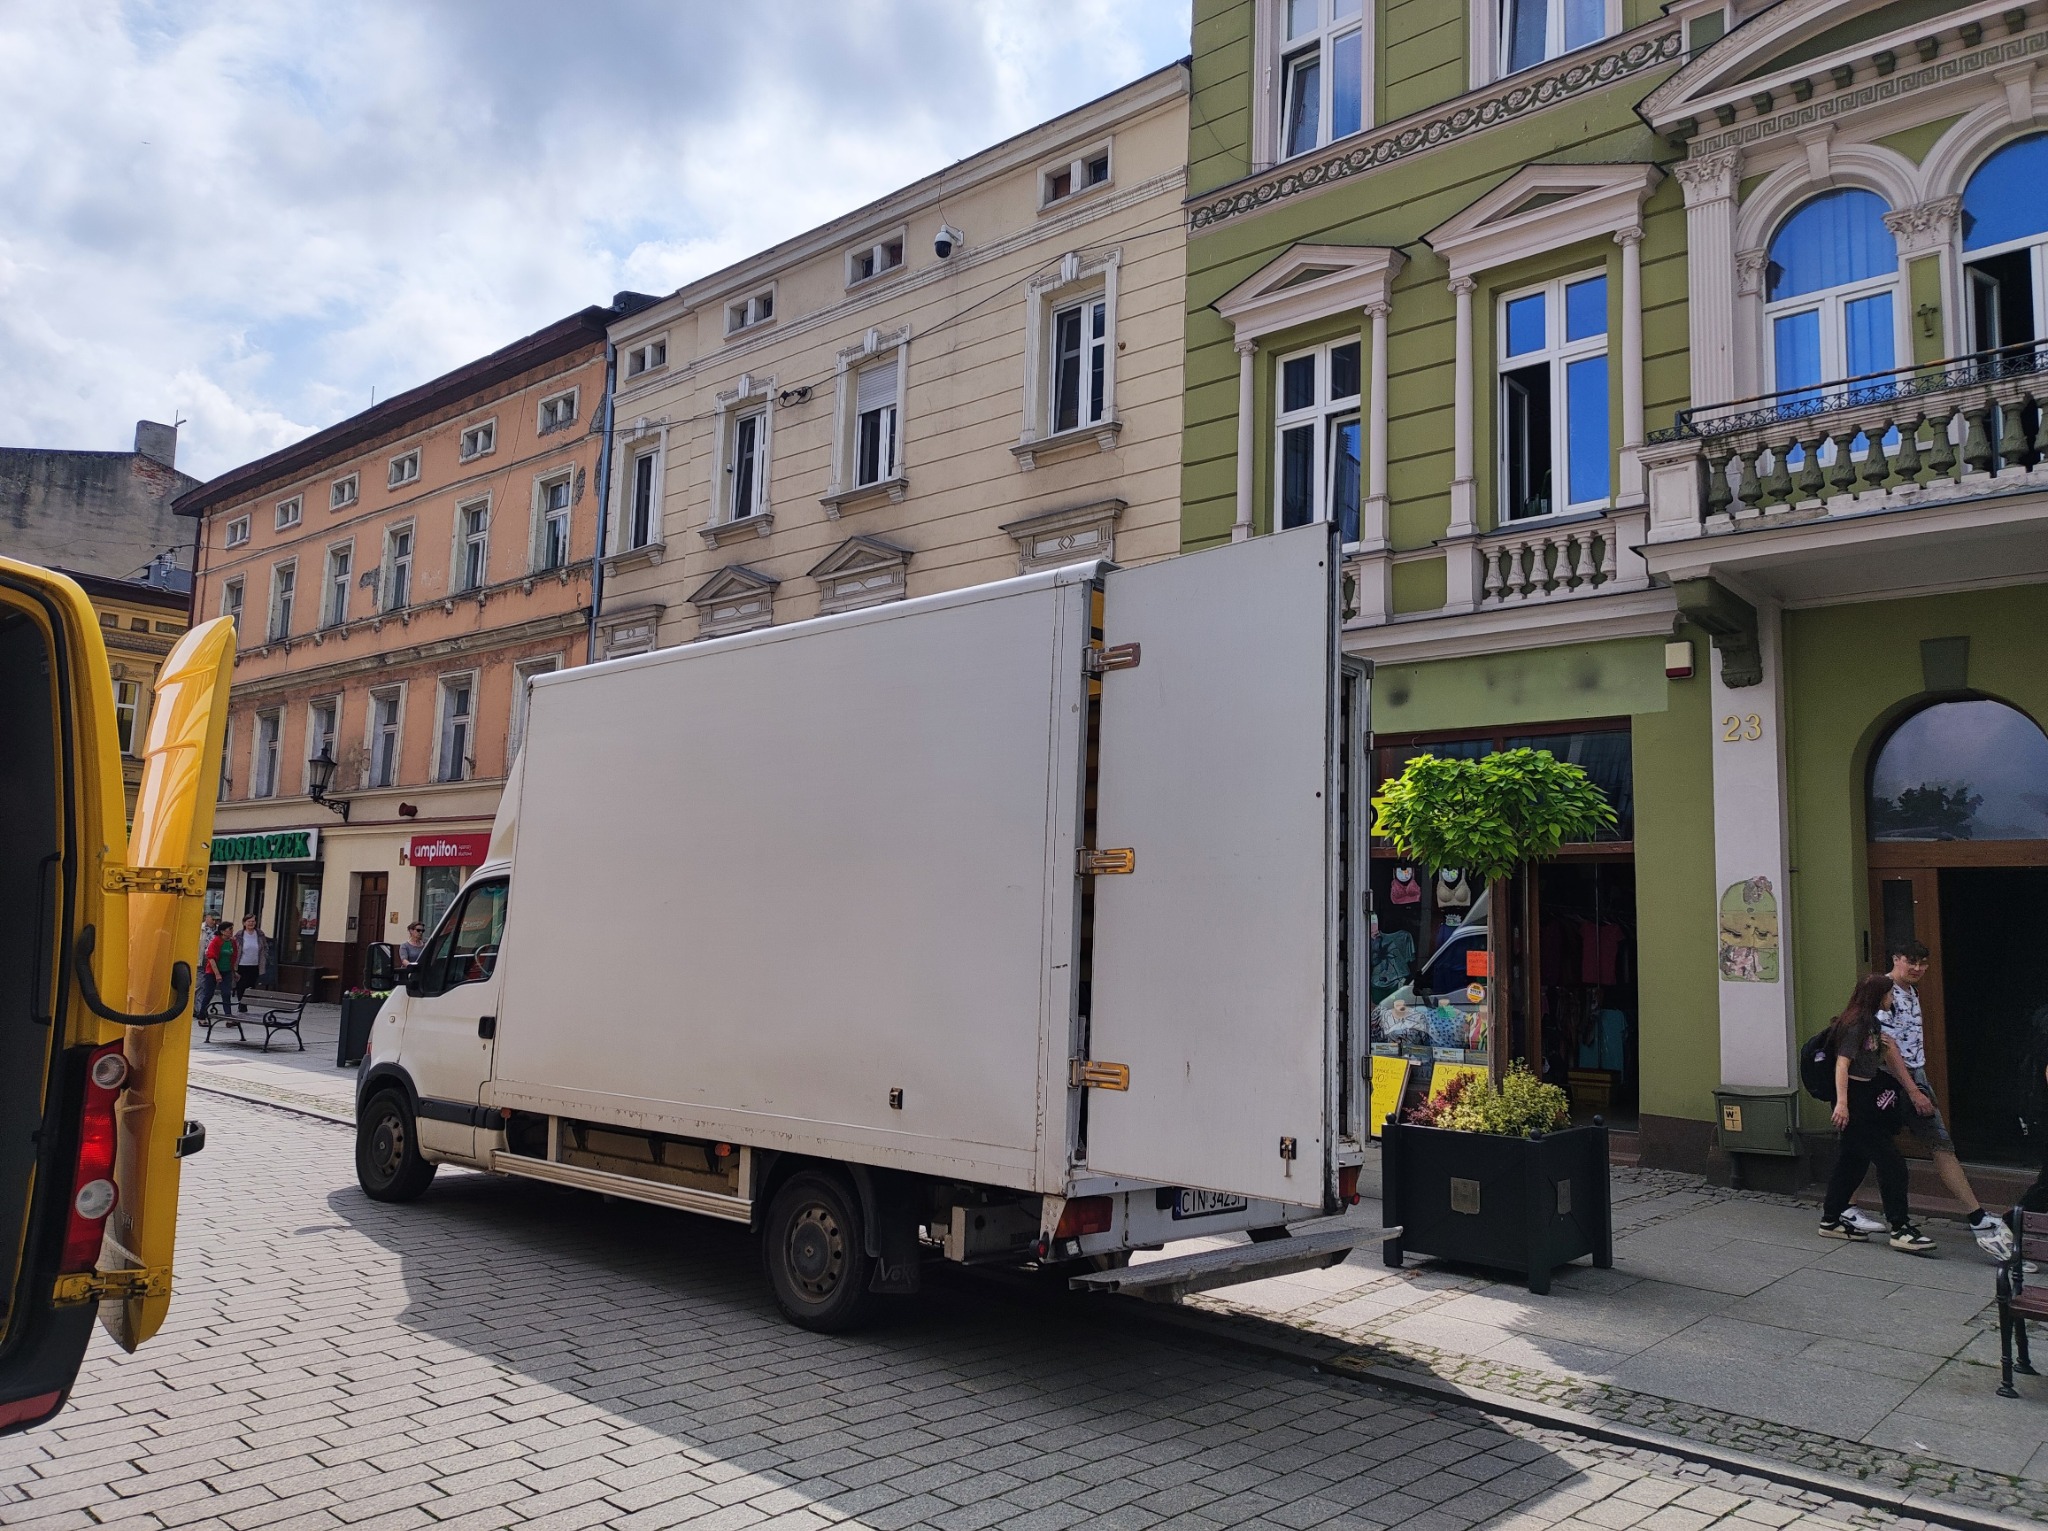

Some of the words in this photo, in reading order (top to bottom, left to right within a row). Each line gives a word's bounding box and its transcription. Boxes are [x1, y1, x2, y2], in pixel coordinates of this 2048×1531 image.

[1722, 713, 1762, 742] 23
[414, 840, 457, 862] amplifon
[1182, 1189, 1206, 1213] CIN
